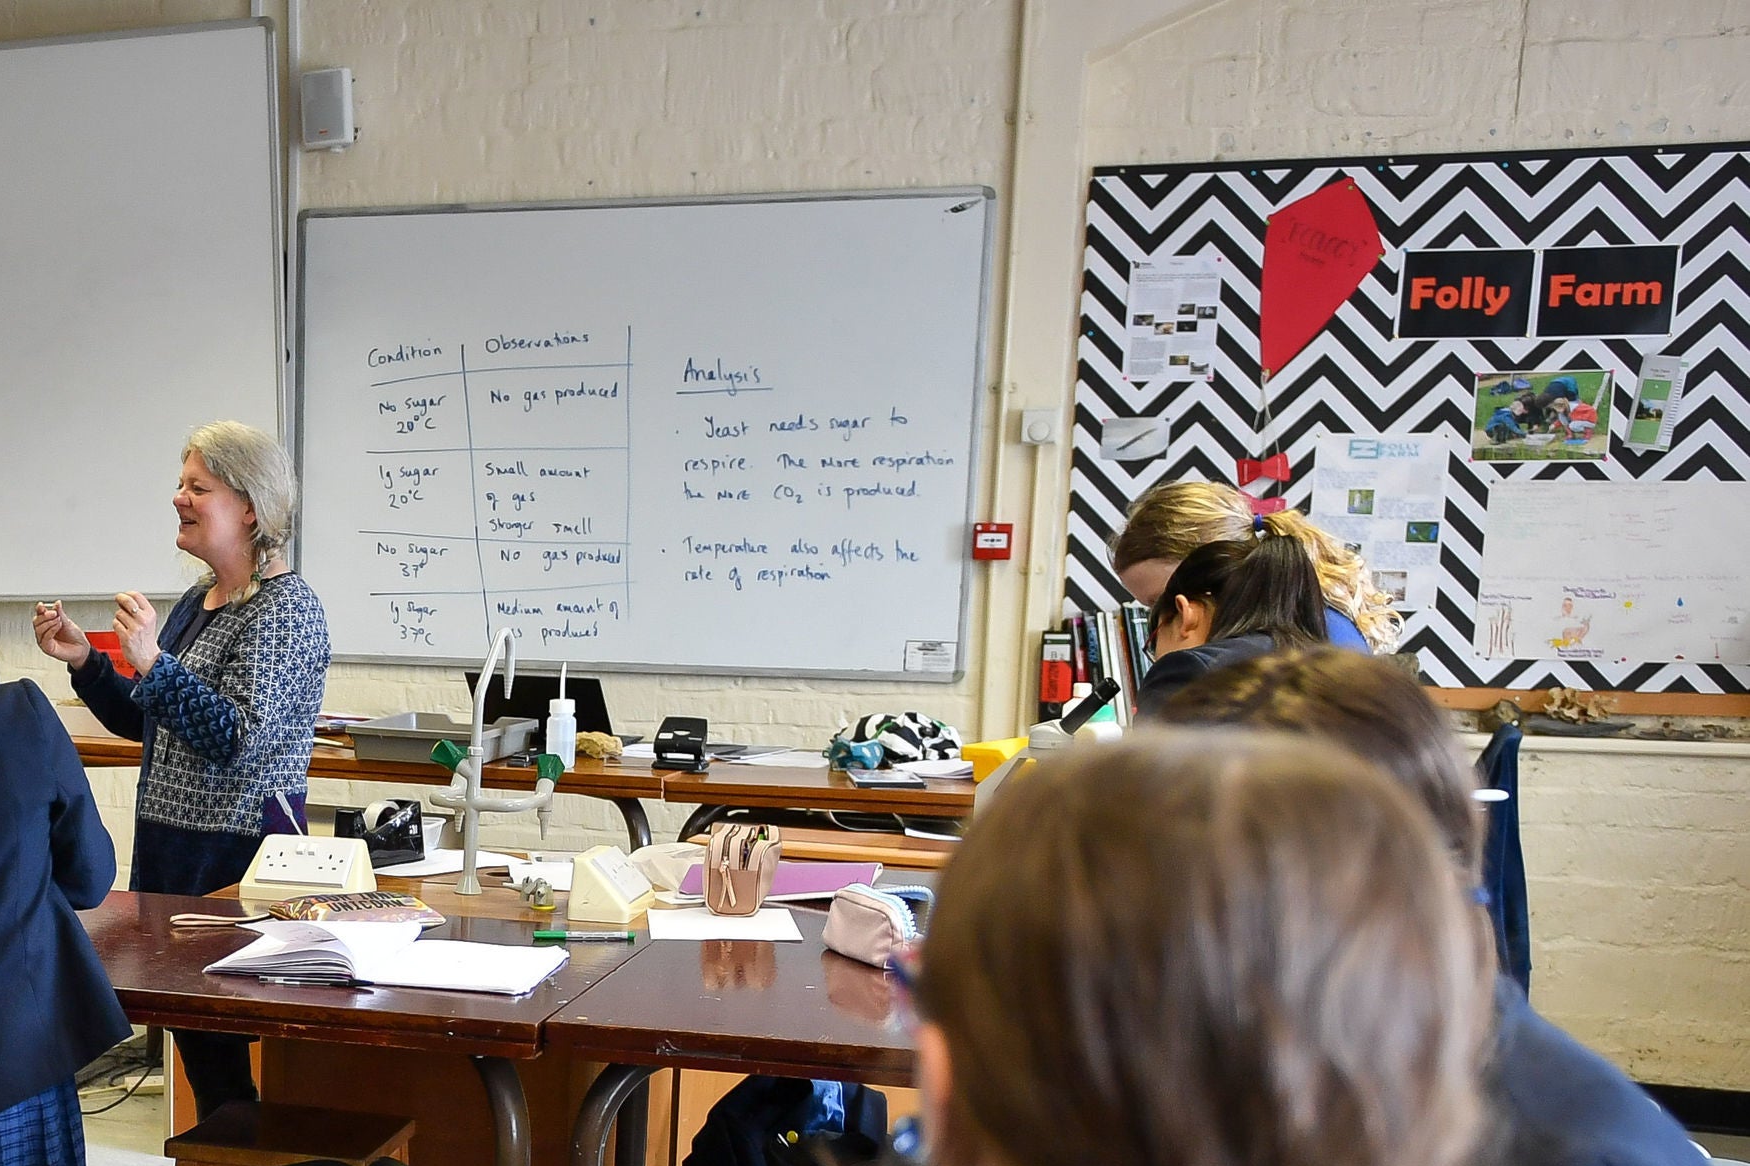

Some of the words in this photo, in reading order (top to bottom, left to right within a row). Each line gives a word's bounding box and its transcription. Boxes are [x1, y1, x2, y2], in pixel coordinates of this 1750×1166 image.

[1409, 276, 1511, 316] Folly
[1548, 274, 1663, 308] Farm
[368, 338, 442, 367] Condition
[485, 332, 589, 354] Observations
[683, 357, 761, 396] Analysis
[379, 401, 397, 415] No
[405, 394, 447, 416] sugar
[490, 390, 511, 404] No
[523, 390, 547, 413] gas
[555, 381, 619, 405] produced
[703, 414, 751, 439] Yeast
[768, 413, 819, 433] needs
[829, 416, 871, 442] sugar
[890, 406, 909, 428] to
[485, 461, 529, 477] Small
[539, 466, 591, 478] amount
[777, 453, 808, 470] The
[872, 449, 955, 474] respiration
[486, 492, 500, 511] of
[512, 492, 536, 511] gas
[683, 481, 705, 500] the
[817, 483, 832, 497] is
[377, 542, 397, 555] No
[500, 549, 521, 562] No
[542, 550, 569, 571] gas
[575, 549, 622, 565] produced
[682, 535, 769, 562] Temperature
[790, 538, 819, 555] also
[831, 538, 885, 567] affects
[895, 539, 920, 563] the
[684, 564, 712, 582] rate
[728, 566, 743, 590] of
[757, 562, 832, 587] respiration
[497, 599, 544, 616] Medium
[556, 600, 604, 615] amount
[609, 600, 620, 620] of
[541, 620, 599, 647] produced
[327, 899, 408, 912] UNICORN
